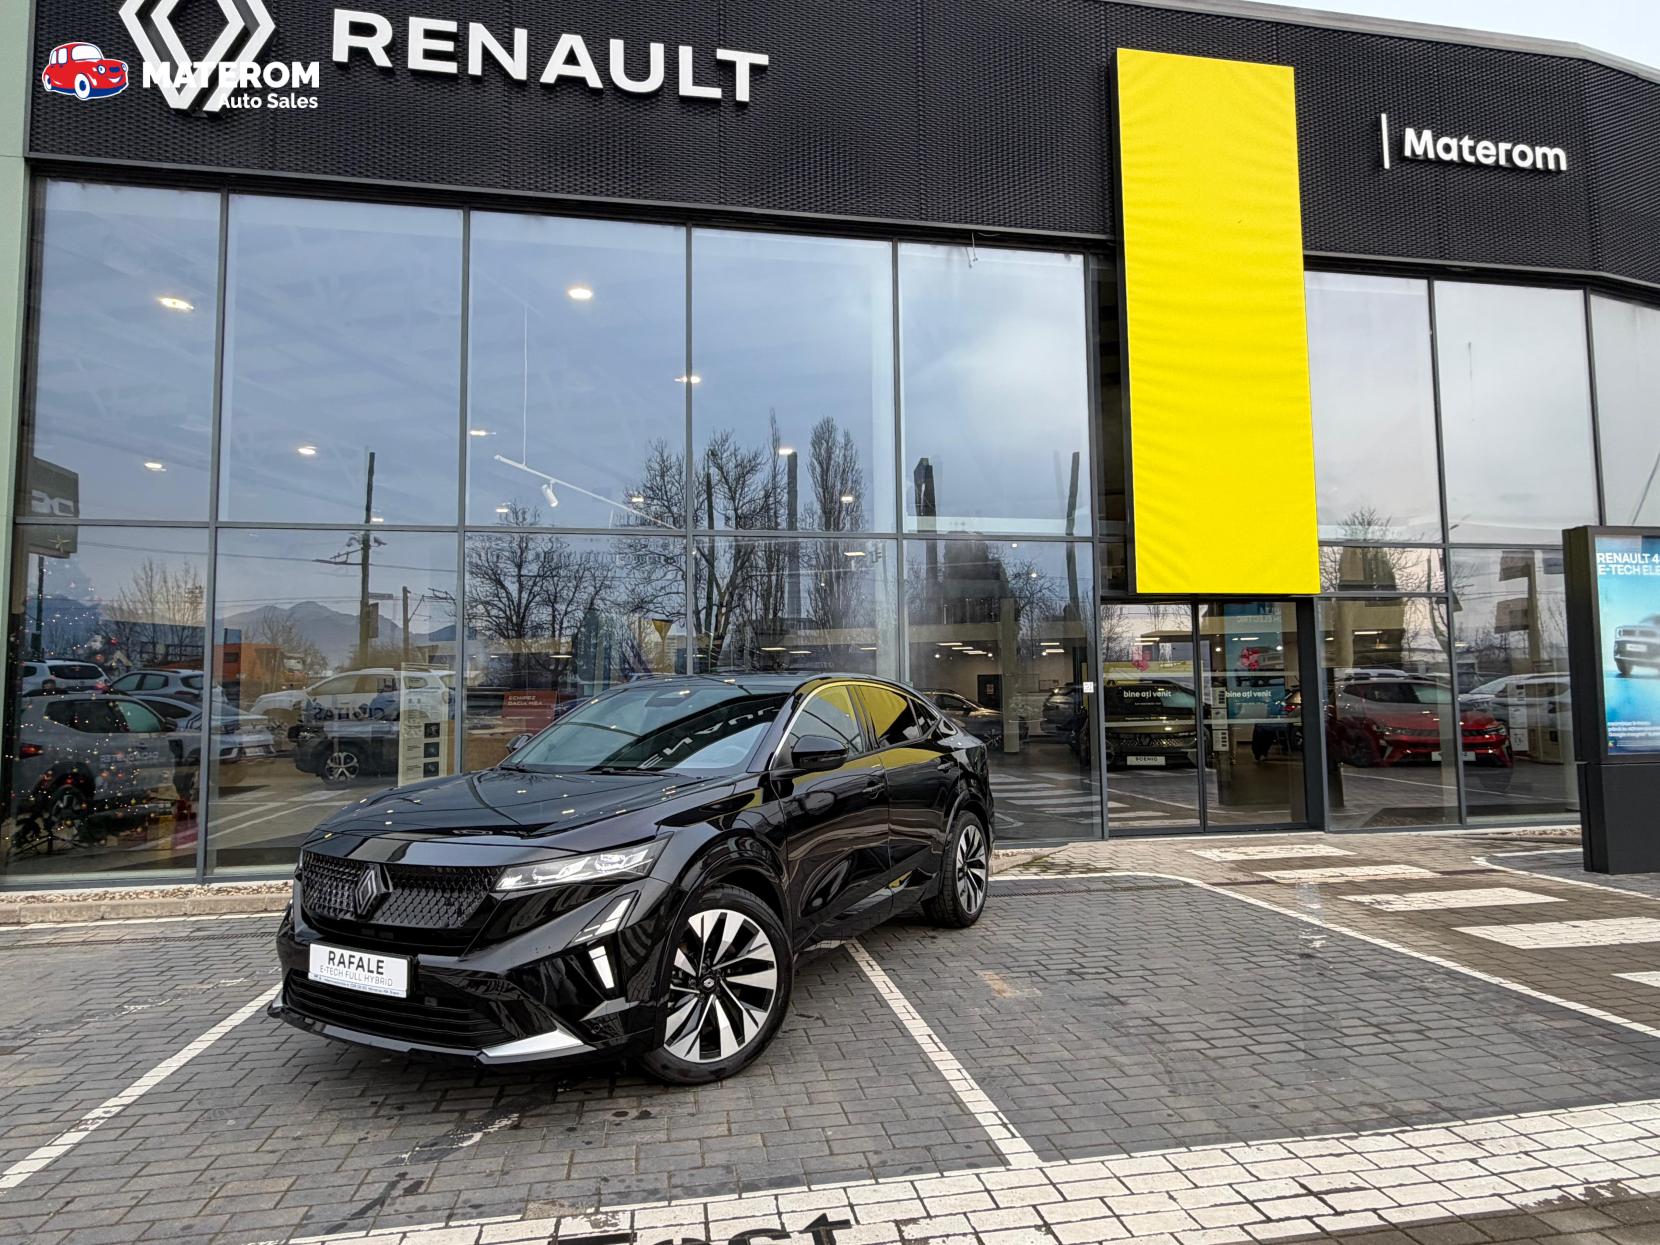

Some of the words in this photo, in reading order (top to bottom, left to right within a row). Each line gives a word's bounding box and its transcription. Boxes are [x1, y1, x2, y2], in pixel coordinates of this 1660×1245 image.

[332, 8, 769, 103] RENAULT
[1403, 127, 1568, 171] Materom
[1596, 552, 1650, 564] RENAULT
[1651, 553, 1660, 565] 4
[1598, 564, 1640, 576] E-TECH
[1123, 690, 1141, 698] bine
[1152, 690, 1171, 698] venit
[1226, 690, 1239, 698] bine
[1252, 690, 1271, 698] venit
[328, 951, 384, 974] RAFALE
[319, 964, 344, 977] E-TECH
[345, 971, 362, 982] FULL
[364, 975, 393, 987] HYBRID
